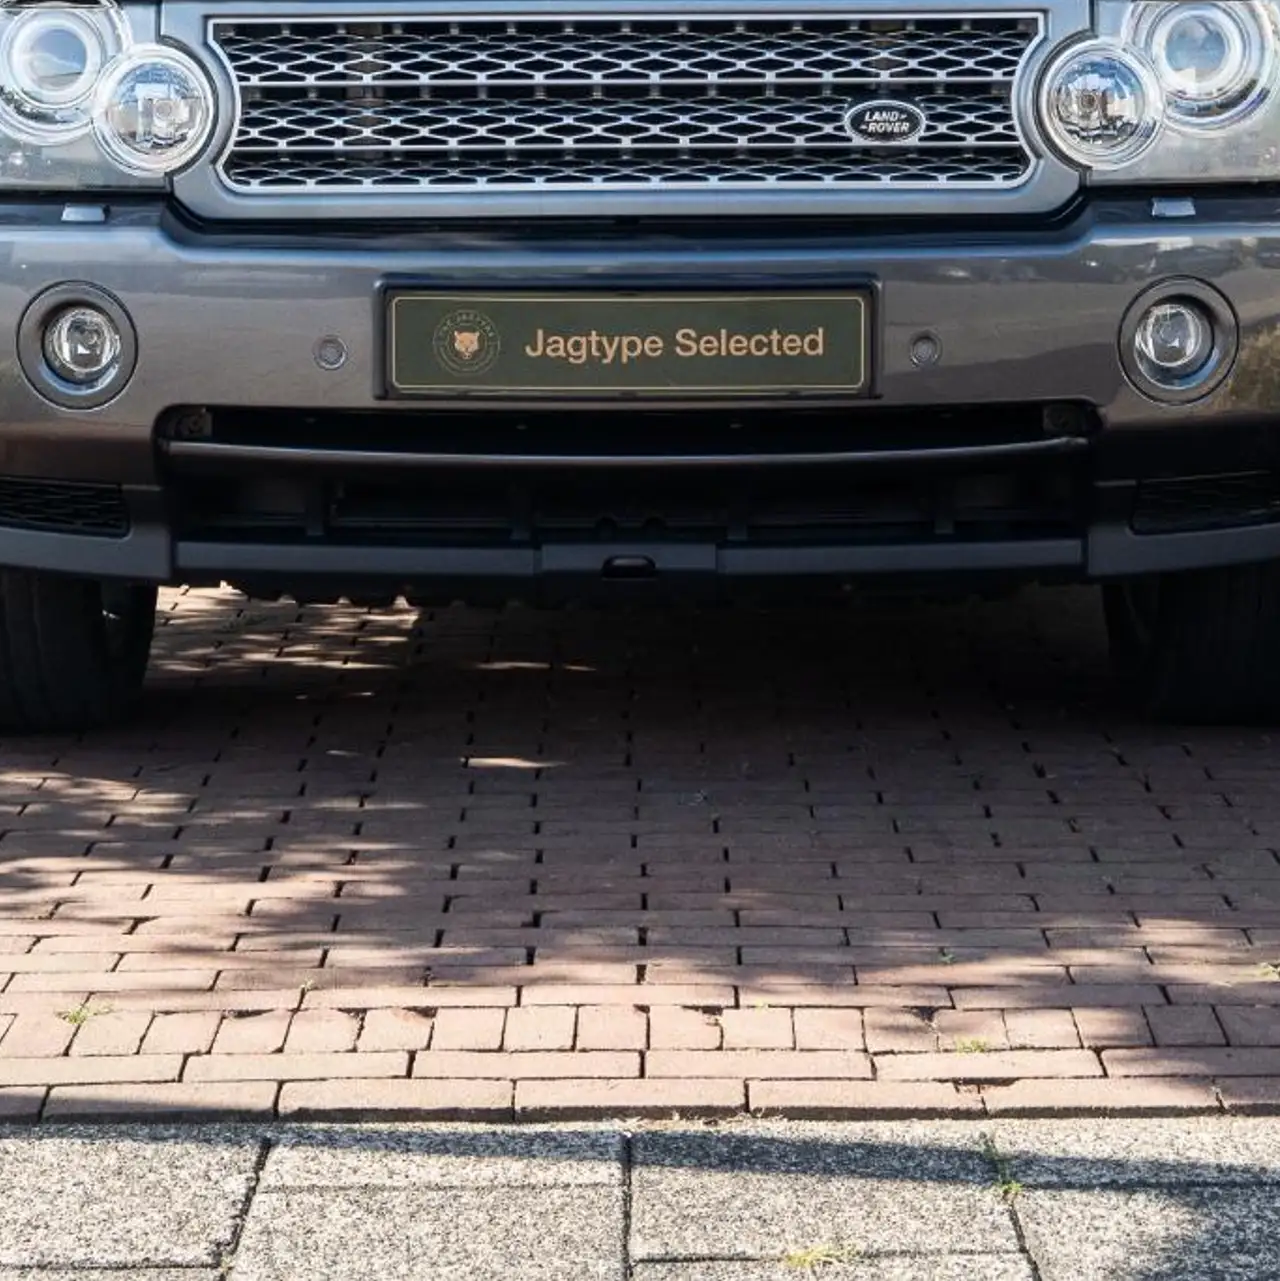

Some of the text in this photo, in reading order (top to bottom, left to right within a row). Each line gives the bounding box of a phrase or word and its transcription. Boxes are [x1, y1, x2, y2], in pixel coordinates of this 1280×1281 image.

[864, 110, 900, 122] LAND
[867, 122, 910, 133] ROVER
[525, 327, 824, 364] Jagtype Selected
